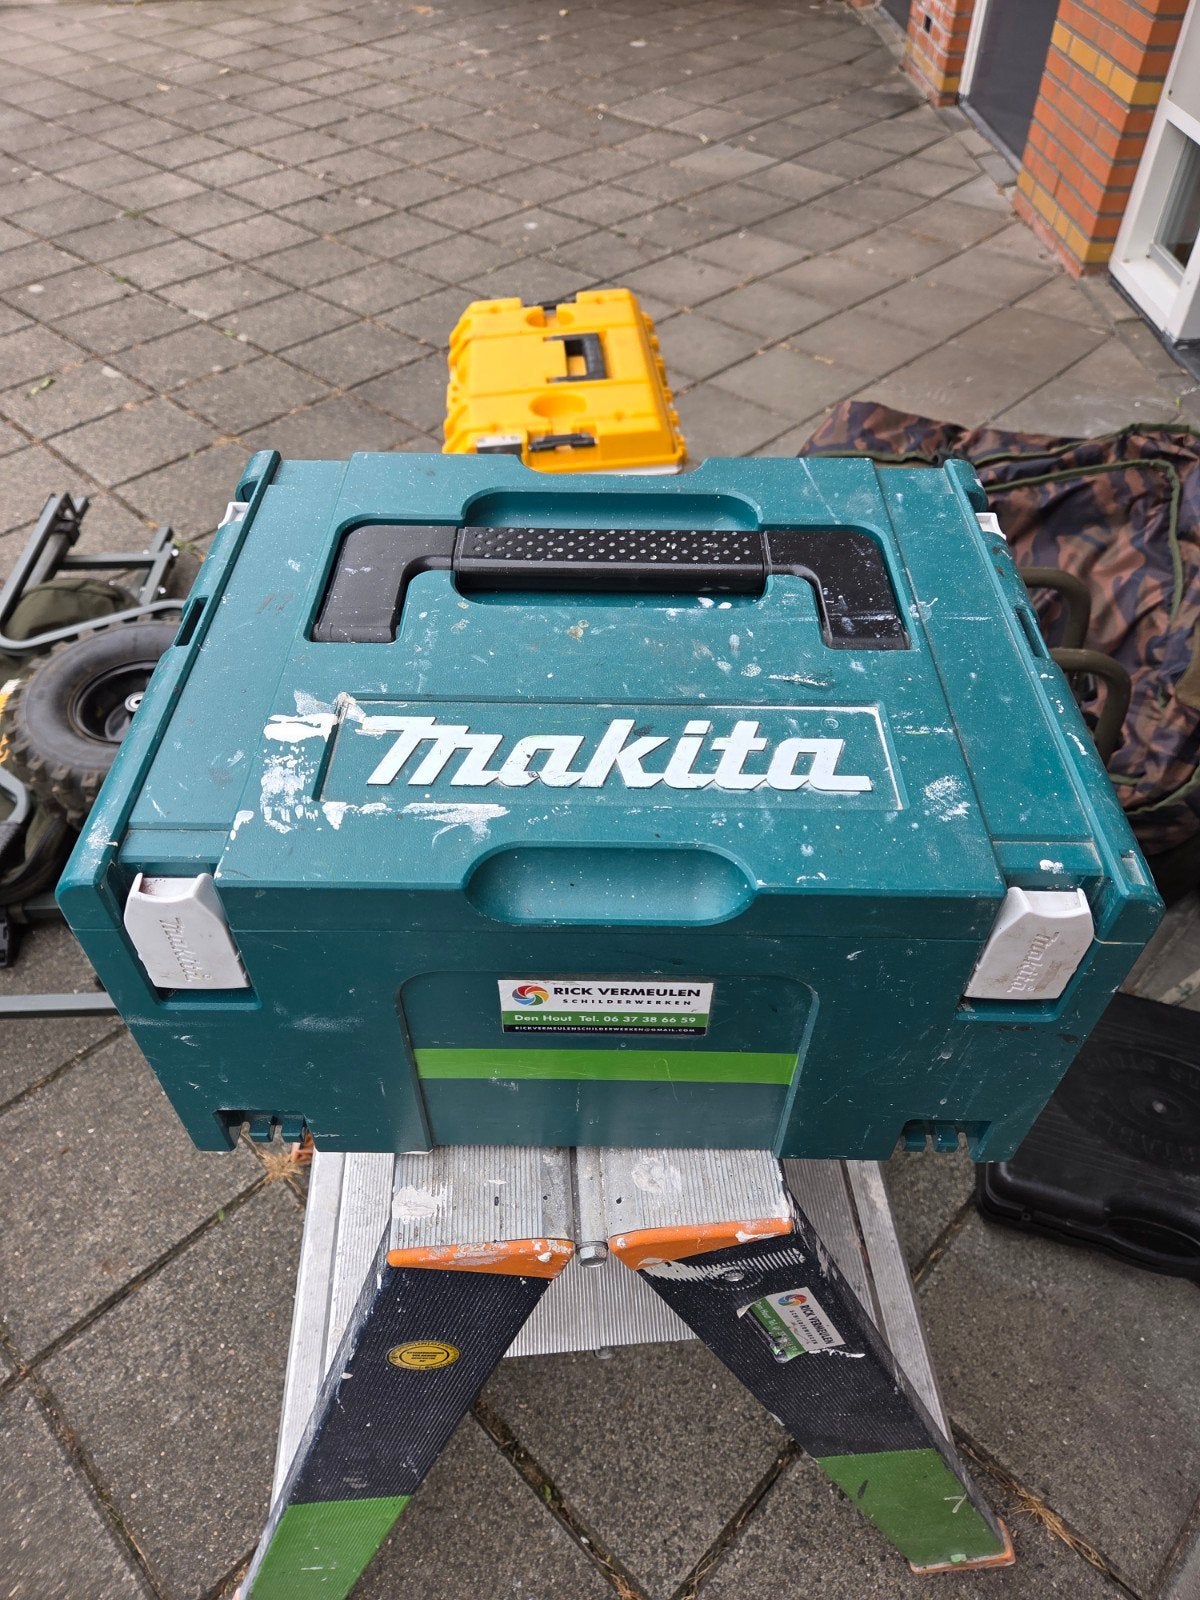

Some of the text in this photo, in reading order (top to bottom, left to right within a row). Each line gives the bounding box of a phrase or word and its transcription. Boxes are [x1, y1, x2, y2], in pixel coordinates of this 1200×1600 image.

[358, 716, 872, 792] Makita
[158, 916, 203, 982] Makita
[553, 987, 701, 997] RICK VERMEULEN
[514, 1014, 539, 1022] Den
[800, 1304, 834, 1345] RICK VERMEULEN
